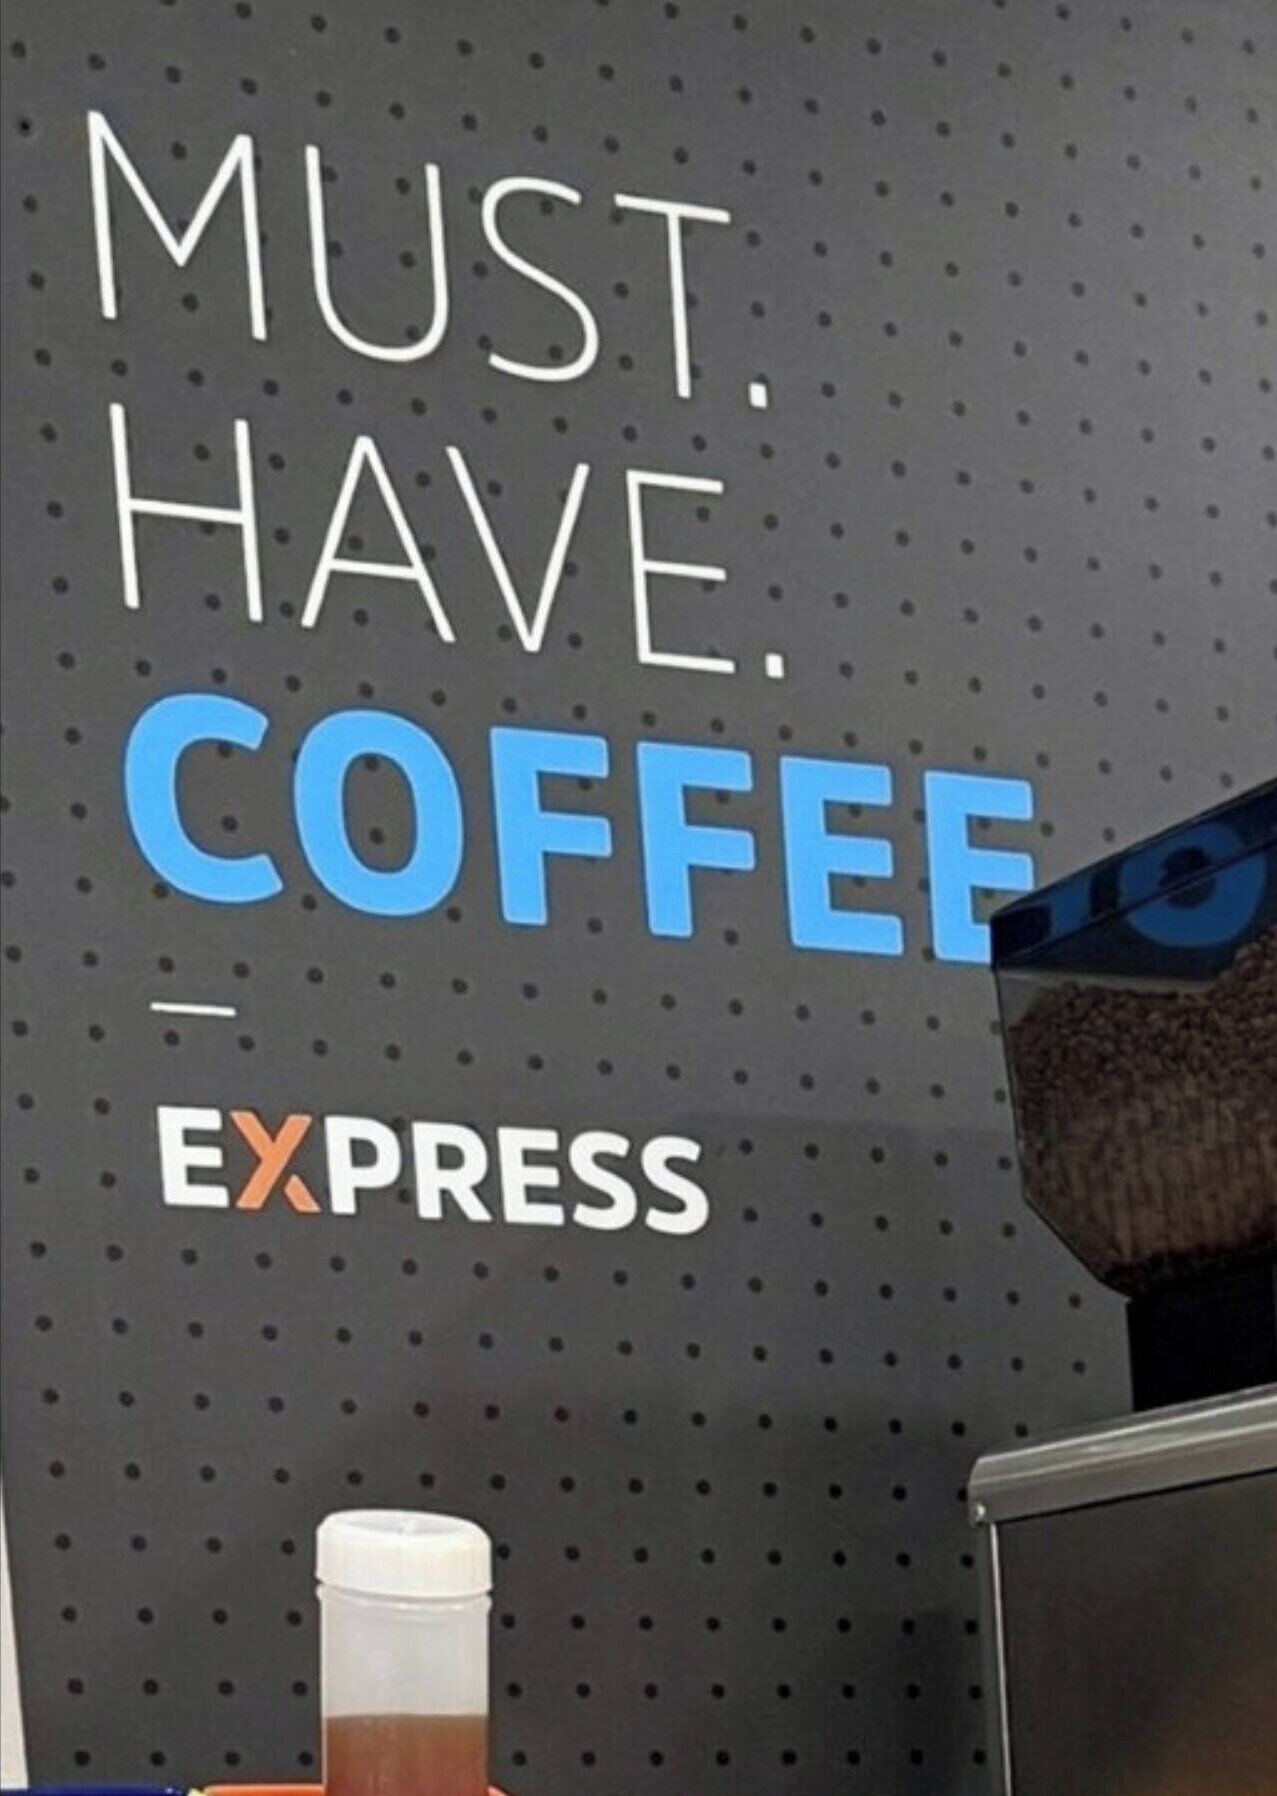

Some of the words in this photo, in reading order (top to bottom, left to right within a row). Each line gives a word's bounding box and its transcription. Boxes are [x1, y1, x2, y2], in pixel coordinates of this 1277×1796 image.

[88, 110, 767, 409] MUST.
[110, 403, 784, 678] HAVE.
[124, 693, 1034, 965] COFFEE
[157, 1106, 709, 1235] EXPRESS
